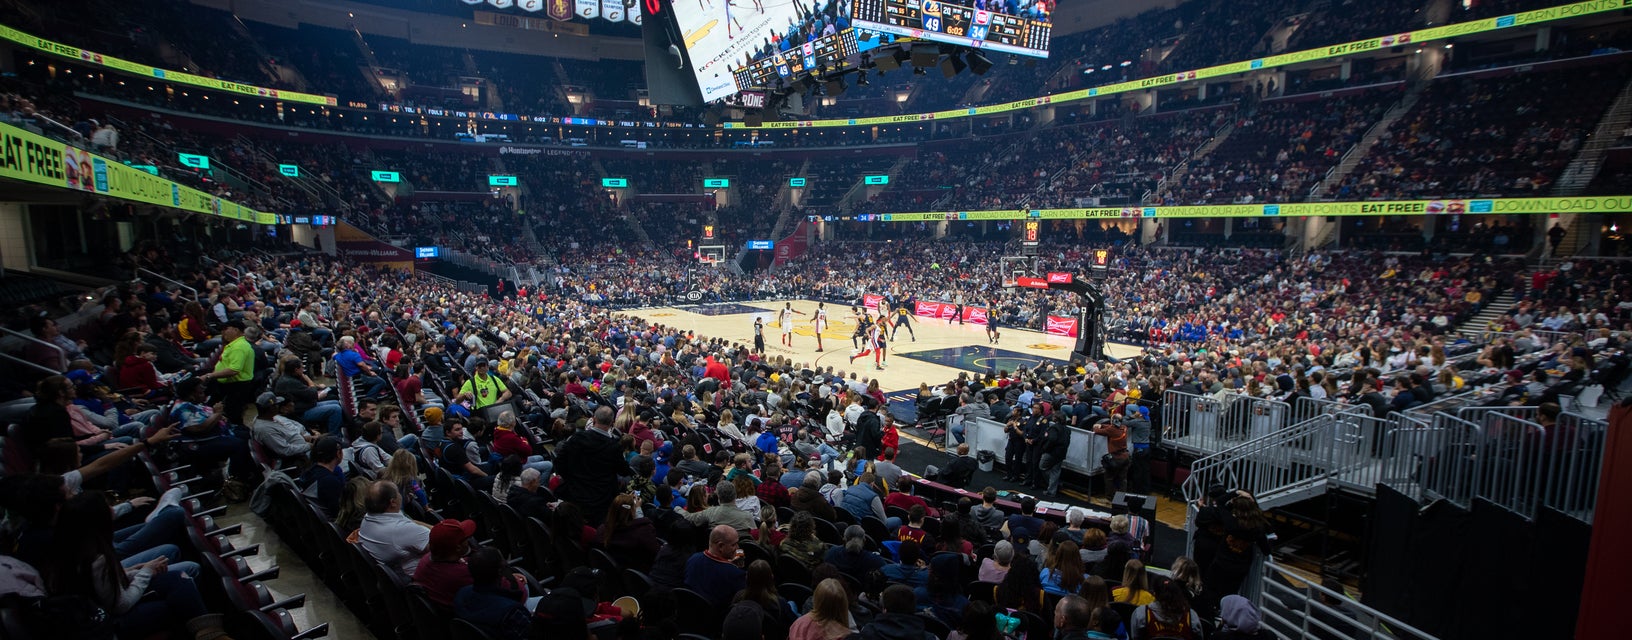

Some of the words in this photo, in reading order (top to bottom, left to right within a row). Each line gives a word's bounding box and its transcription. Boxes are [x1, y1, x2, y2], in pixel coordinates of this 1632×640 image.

[1516, 8, 1556, 24] EARN
[1560, 0, 1620, 18] POINTS
[926, 18, 939, 31] 49
[946, 26, 964, 36] 6:02
[1413, 20, 1493, 41] THELUBE.COM
[972, 26, 984, 38] 34
[38, 39, 52, 50] EAT
[54, 44, 80, 58] FREE!
[699, 43, 736, 72] ROCKET
[736, 16, 772, 46] Mortgage
[1263, 55, 1290, 66] EARN
[1290, 50, 1326, 62] POINTS
[1328, 44, 1348, 56] EAT
[1350, 39, 1380, 52] FREE!
[792, 64, 803, 72] 6:02
[806, 58, 815, 68] 34
[780, 66, 788, 76] 49
[221, 81, 235, 90] EAT
[237, 84, 258, 94] FREE!
[1116, 82, 1140, 92] POINTS
[1142, 78, 1154, 88] EAT
[1155, 76, 1176, 85] FREE!
[1022, 100, 1036, 108] FREE!
[26, 140, 64, 180] FREE!
[1156, 206, 1209, 216] DOWNLOAD
[1211, 206, 1232, 215] OUR
[1234, 205, 1255, 214] APP
[1280, 204, 1311, 215] EARN
[1314, 204, 1358, 214] POINTS
[1361, 204, 1385, 213] EAT
[1387, 202, 1425, 212] FREE!
[1495, 198, 1598, 211] DOWNLOAD
[1604, 198, 1632, 210] OU
[968, 211, 1000, 219] DOWNLOAD
[1000, 210, 1013, 219] OUR
[1040, 210, 1058, 218] EARN
[1060, 210, 1084, 218] POINTS
[1100, 209, 1120, 217] FREE!
[1028, 230, 1036, 240] 18
